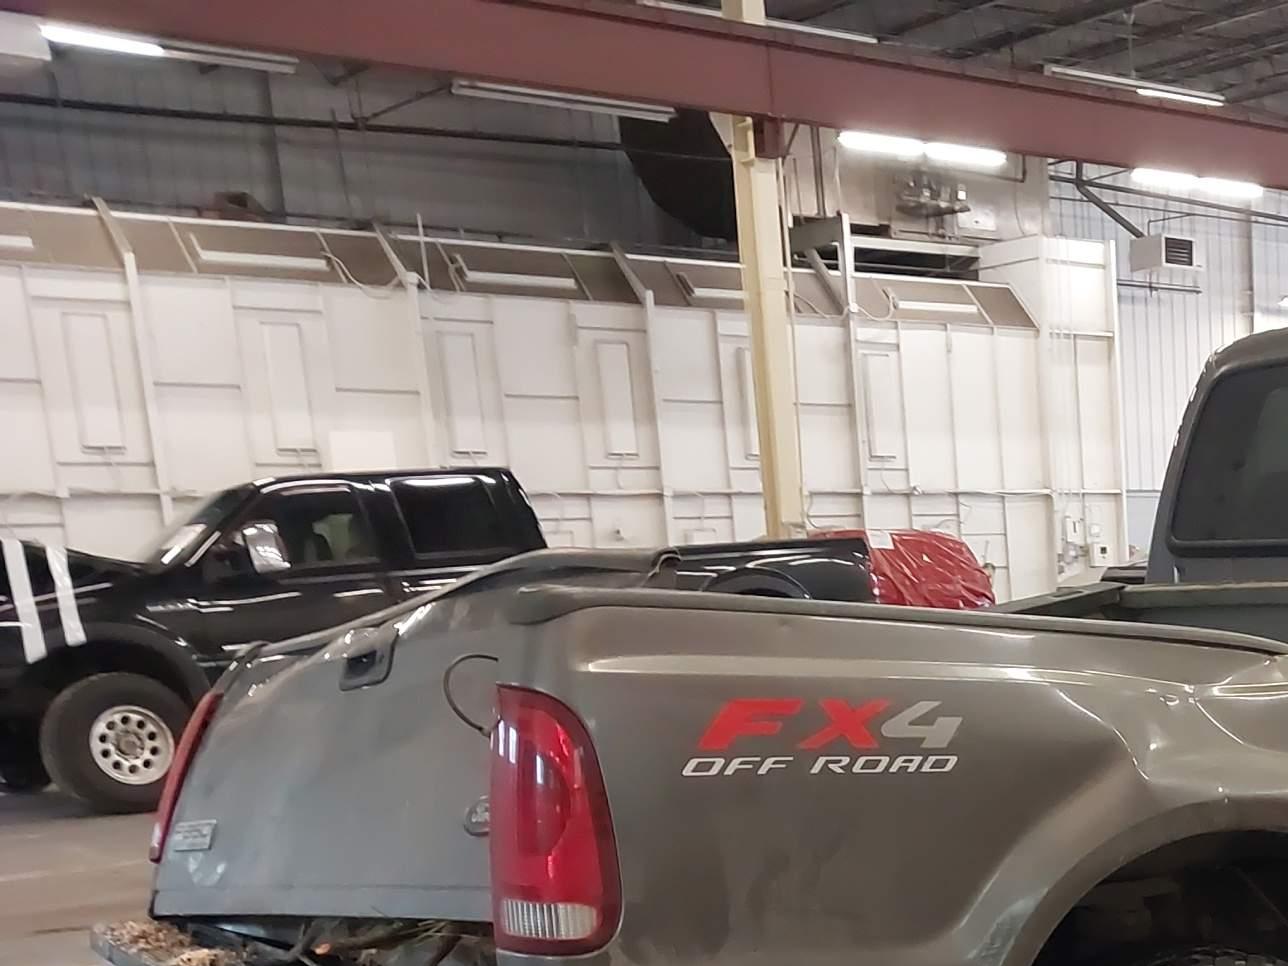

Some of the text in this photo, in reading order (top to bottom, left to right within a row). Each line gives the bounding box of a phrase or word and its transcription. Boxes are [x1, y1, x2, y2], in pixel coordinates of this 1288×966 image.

[697, 698, 963, 749] FX4
[681, 755, 959, 776] OFF ROAD
